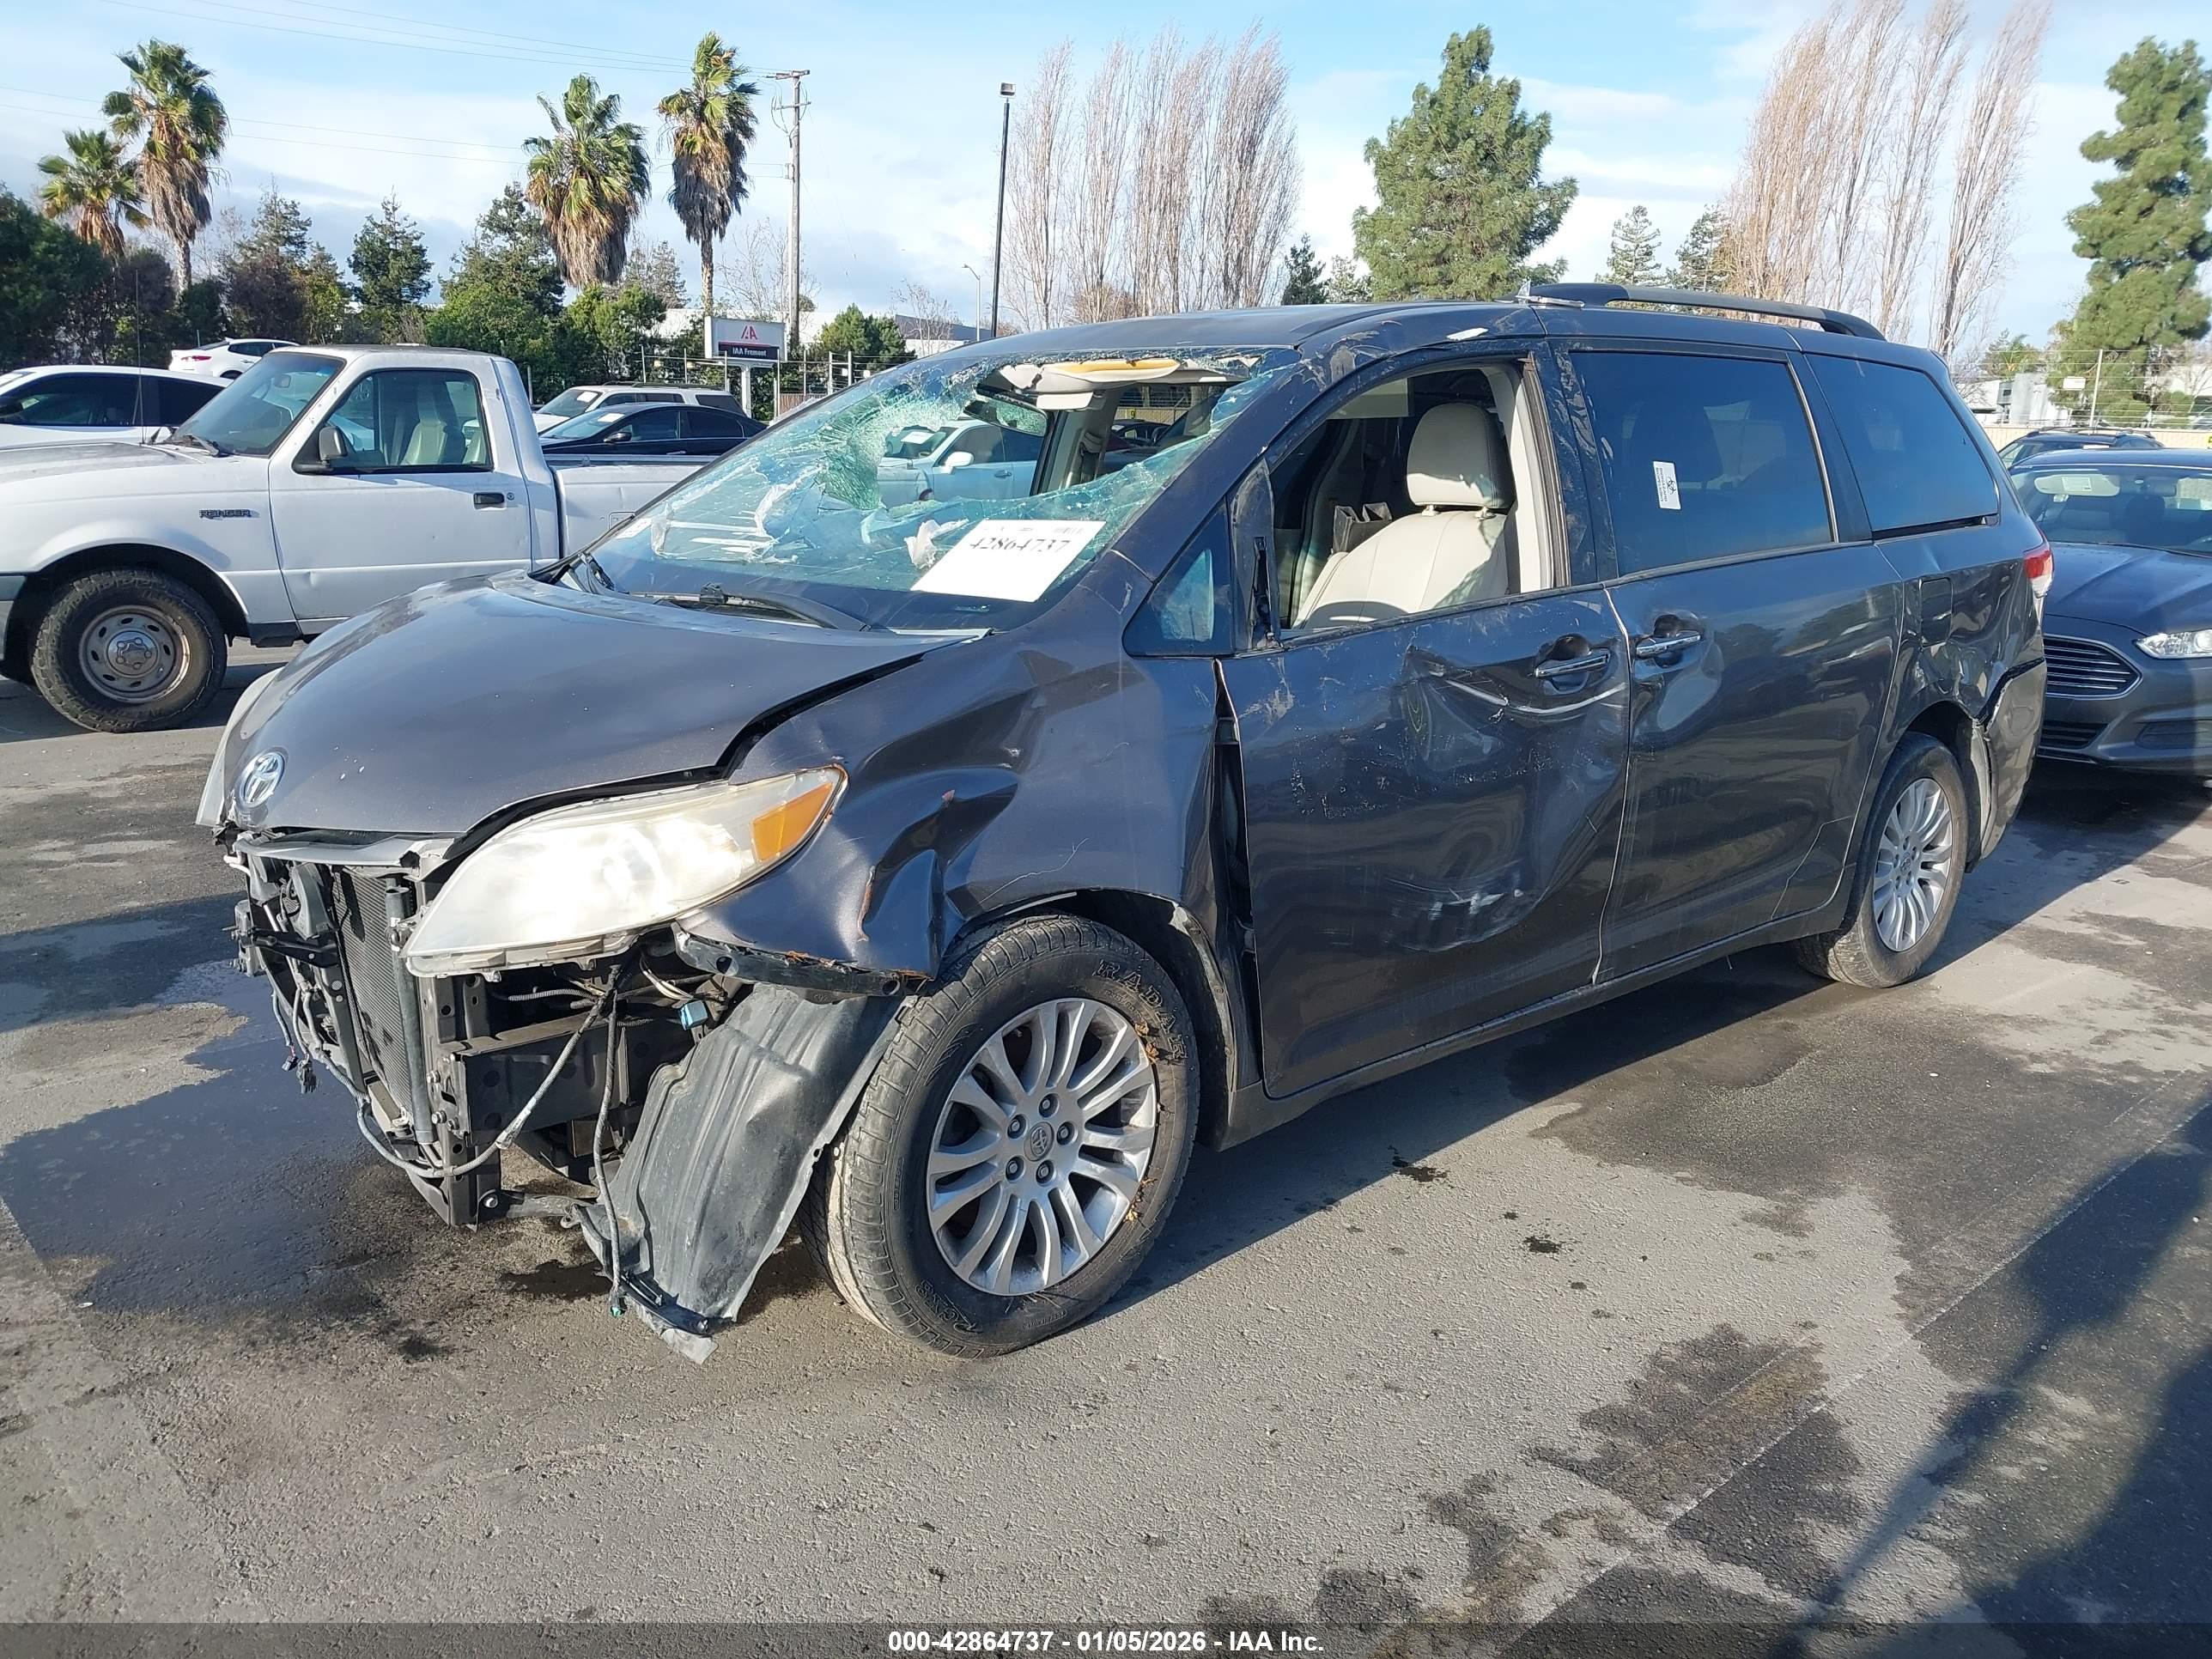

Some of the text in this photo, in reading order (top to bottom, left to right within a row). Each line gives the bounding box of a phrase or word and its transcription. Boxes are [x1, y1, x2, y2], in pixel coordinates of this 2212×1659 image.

[744, 348, 767, 356] Fremont
[199, 509, 252, 519] RANGER
[969, 537, 1072, 552] 42864737
[1092, 959, 1188, 1060] RADAR
